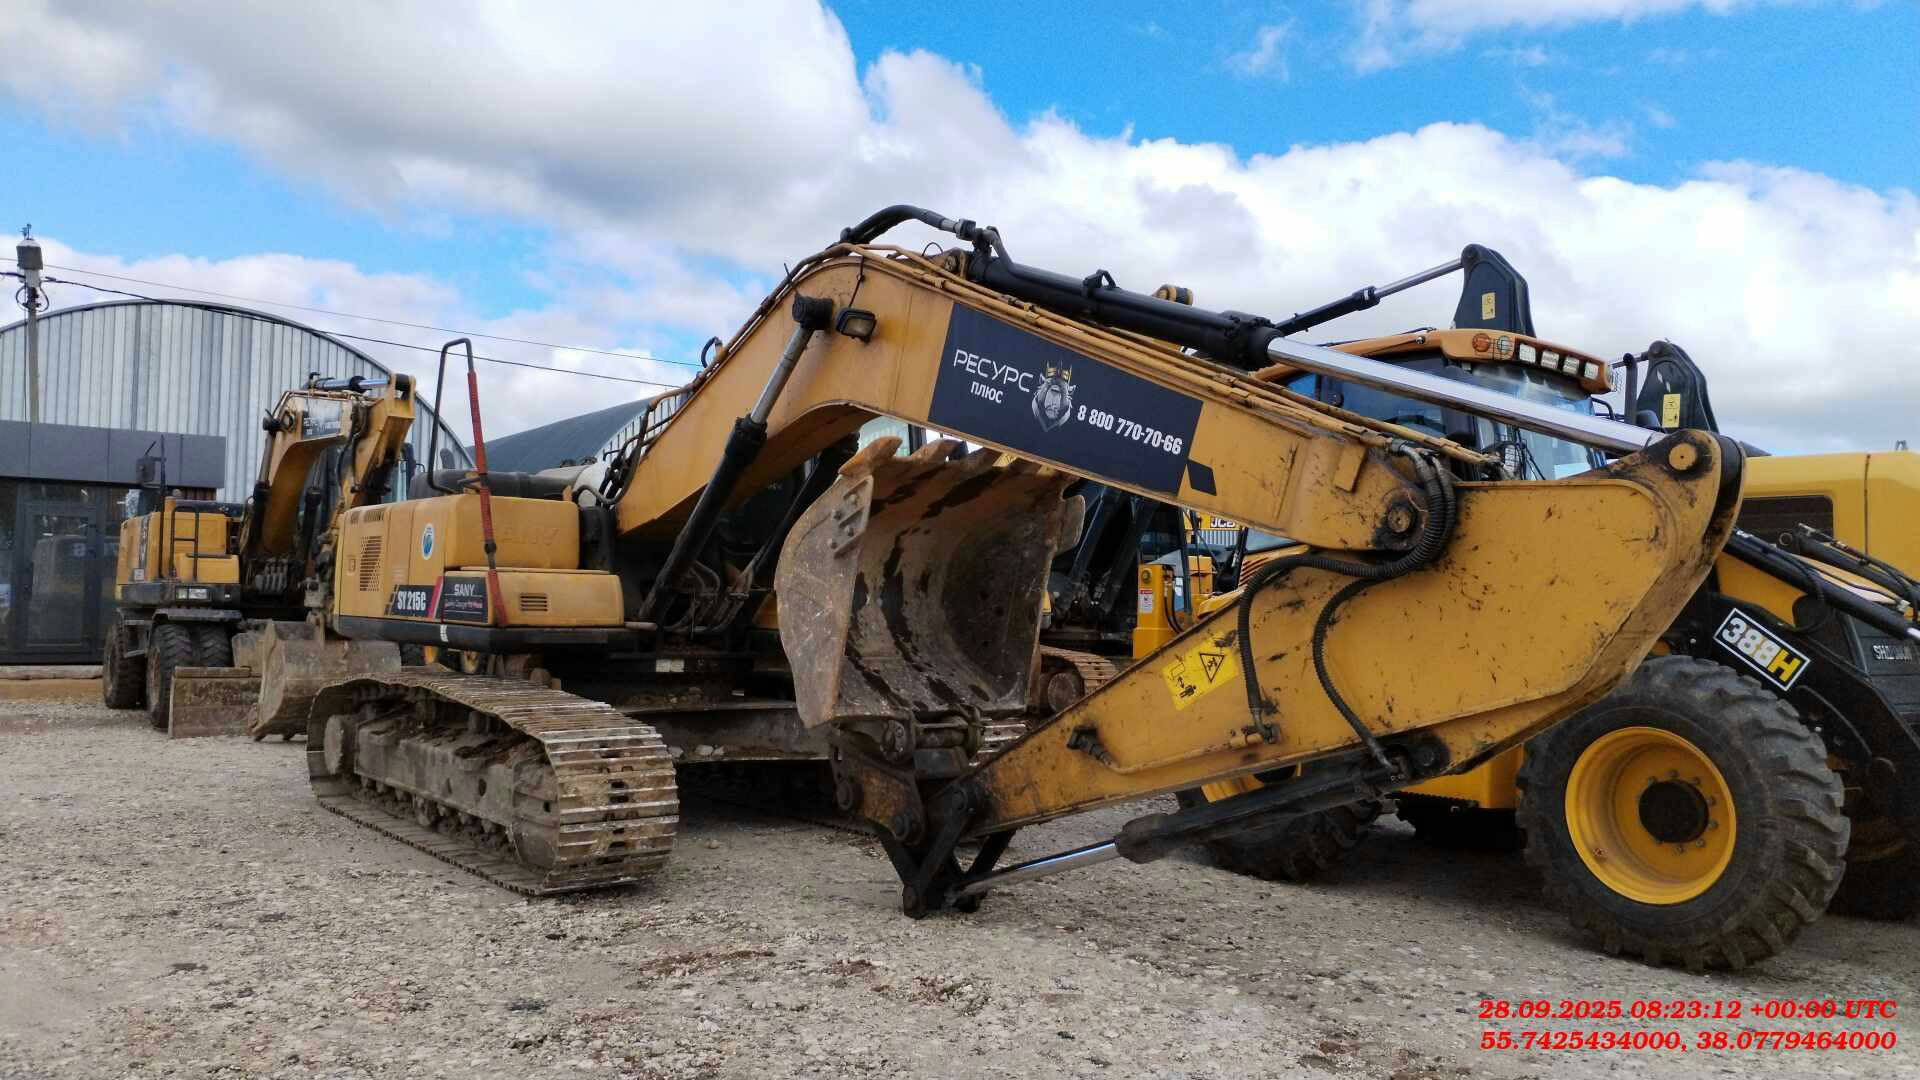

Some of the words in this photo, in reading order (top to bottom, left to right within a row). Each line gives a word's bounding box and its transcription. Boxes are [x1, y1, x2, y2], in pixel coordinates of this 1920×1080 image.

[953, 349, 1034, 393] РЕСУРС
[1077, 404, 1087, 421] 8
[1088, 408, 1114, 431] 800
[1115, 417, 1183, 455] 770-70-66
[454, 583, 475, 597] SANY
[1721, 617, 1802, 682] 388H
